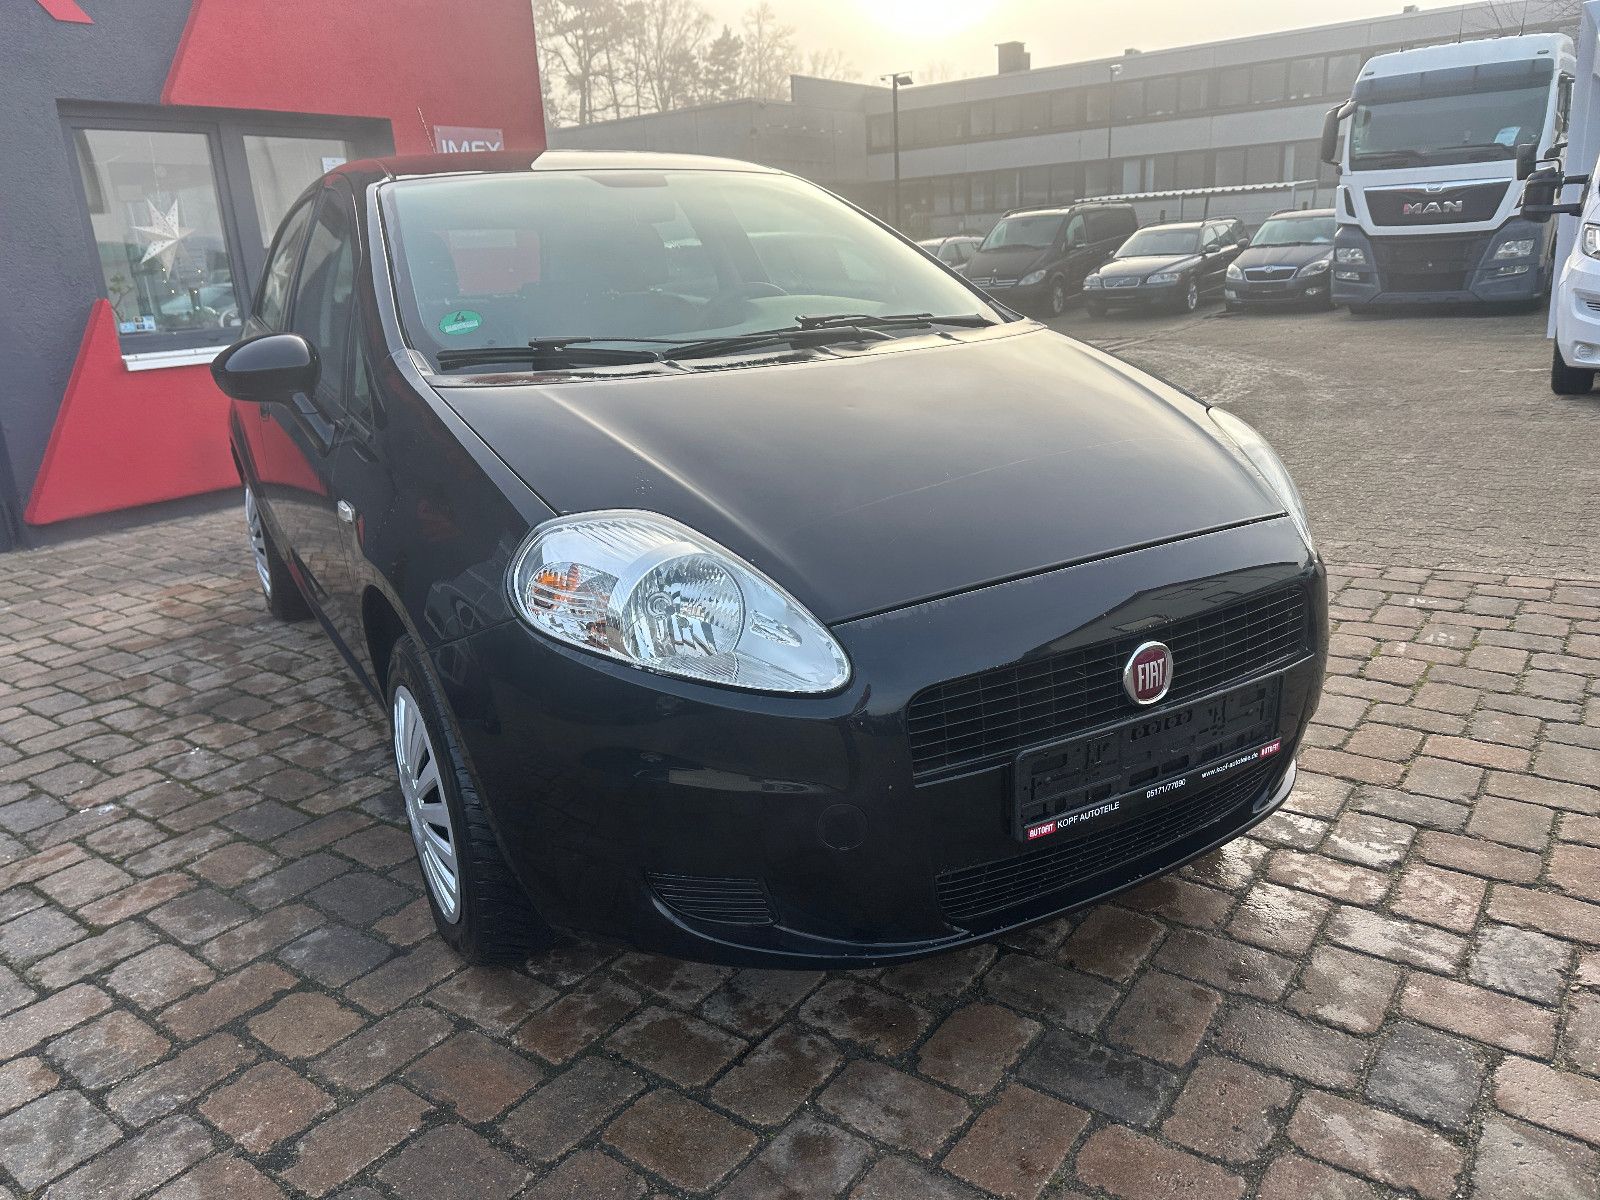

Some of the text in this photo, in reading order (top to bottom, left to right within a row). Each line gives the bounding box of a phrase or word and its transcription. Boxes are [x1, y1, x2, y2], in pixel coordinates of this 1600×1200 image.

[1403, 200, 1463, 215] MAN
[1137, 657, 1165, 692] FIAT
[1029, 823, 1054, 838] AUTOFIT
[1057, 815, 1079, 829] KOPF
[1079, 801, 1120, 822] AUTOTEILE
[1201, 752, 1259, 779] www.kopf-autoteile.de
